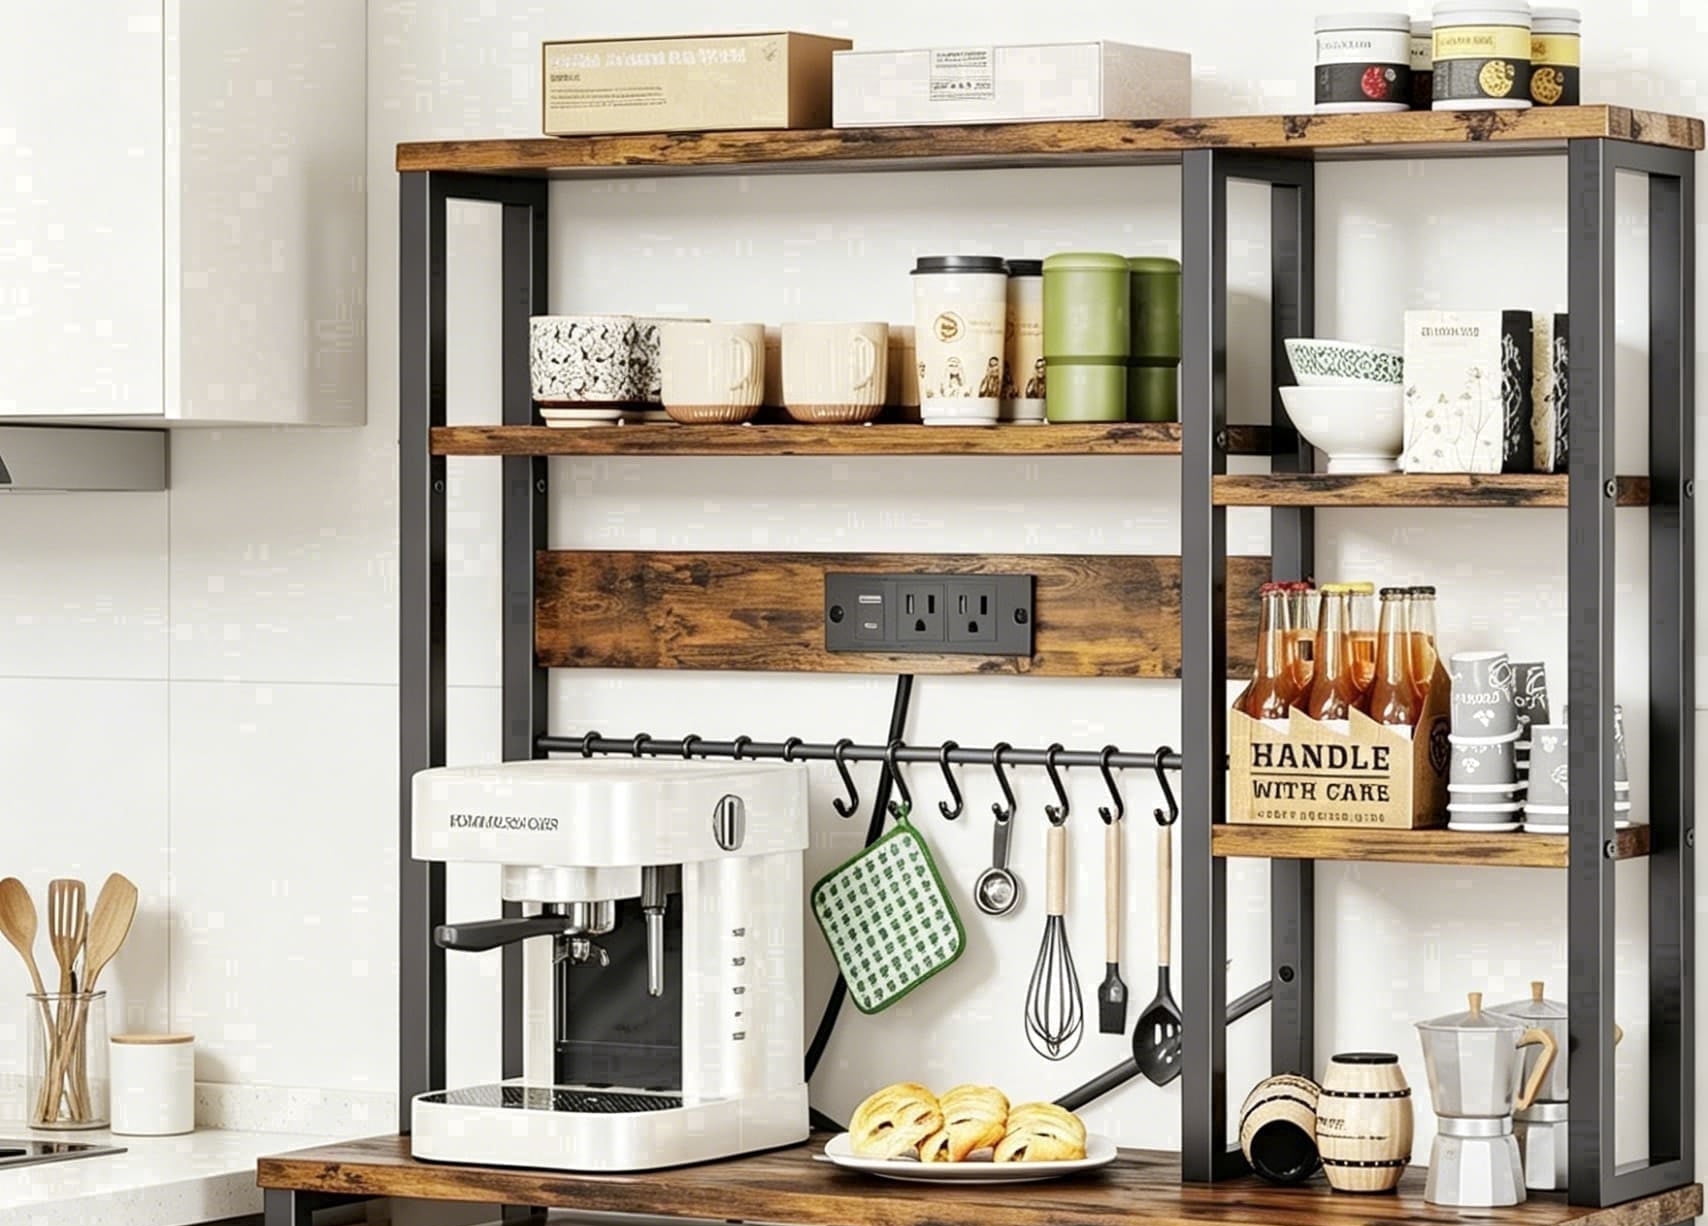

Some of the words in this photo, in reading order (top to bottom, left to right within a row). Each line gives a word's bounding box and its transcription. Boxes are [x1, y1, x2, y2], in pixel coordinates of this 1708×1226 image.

[1251, 742, 1390, 771] HANDLE
[1252, 779, 1317, 801] WITH
[1326, 782, 1391, 802] CARE
